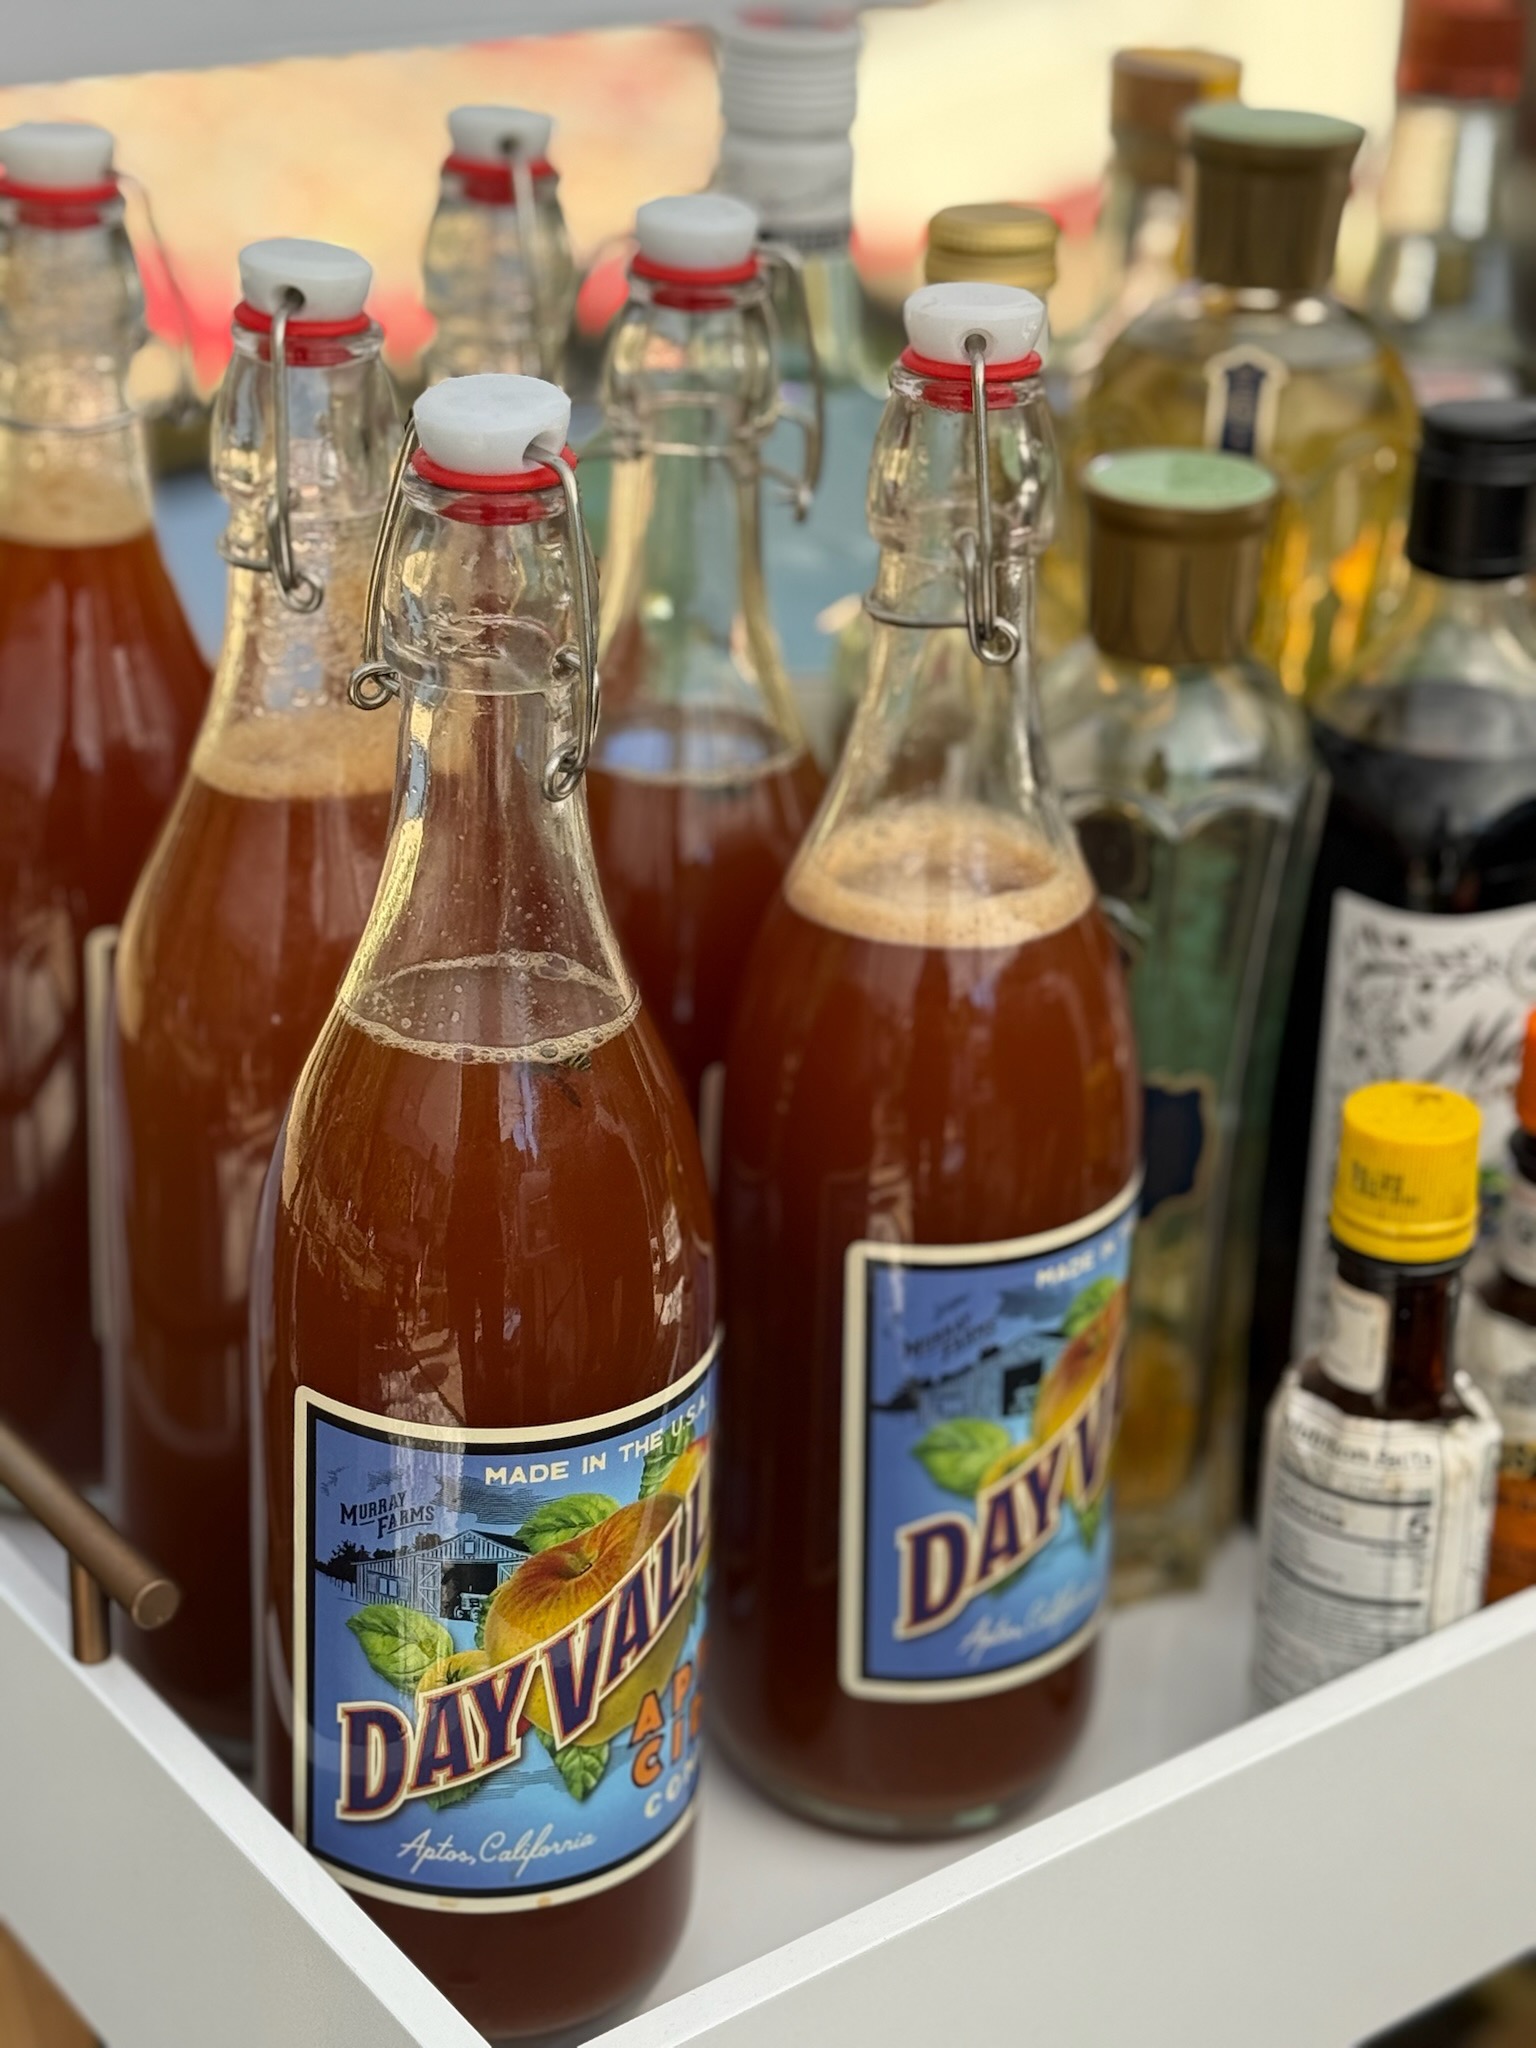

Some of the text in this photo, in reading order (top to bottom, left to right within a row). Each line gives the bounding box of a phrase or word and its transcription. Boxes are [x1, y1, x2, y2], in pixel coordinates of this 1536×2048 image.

[484, 1460, 569, 1487] MADE
[581, 1451, 606, 1476] IN
[618, 1428, 663, 1463] THE
[339, 1491, 408, 1527] MURRAY
[377, 1503, 436, 1540] FARMS
[397, 1822, 598, 1879] Aptos, California
